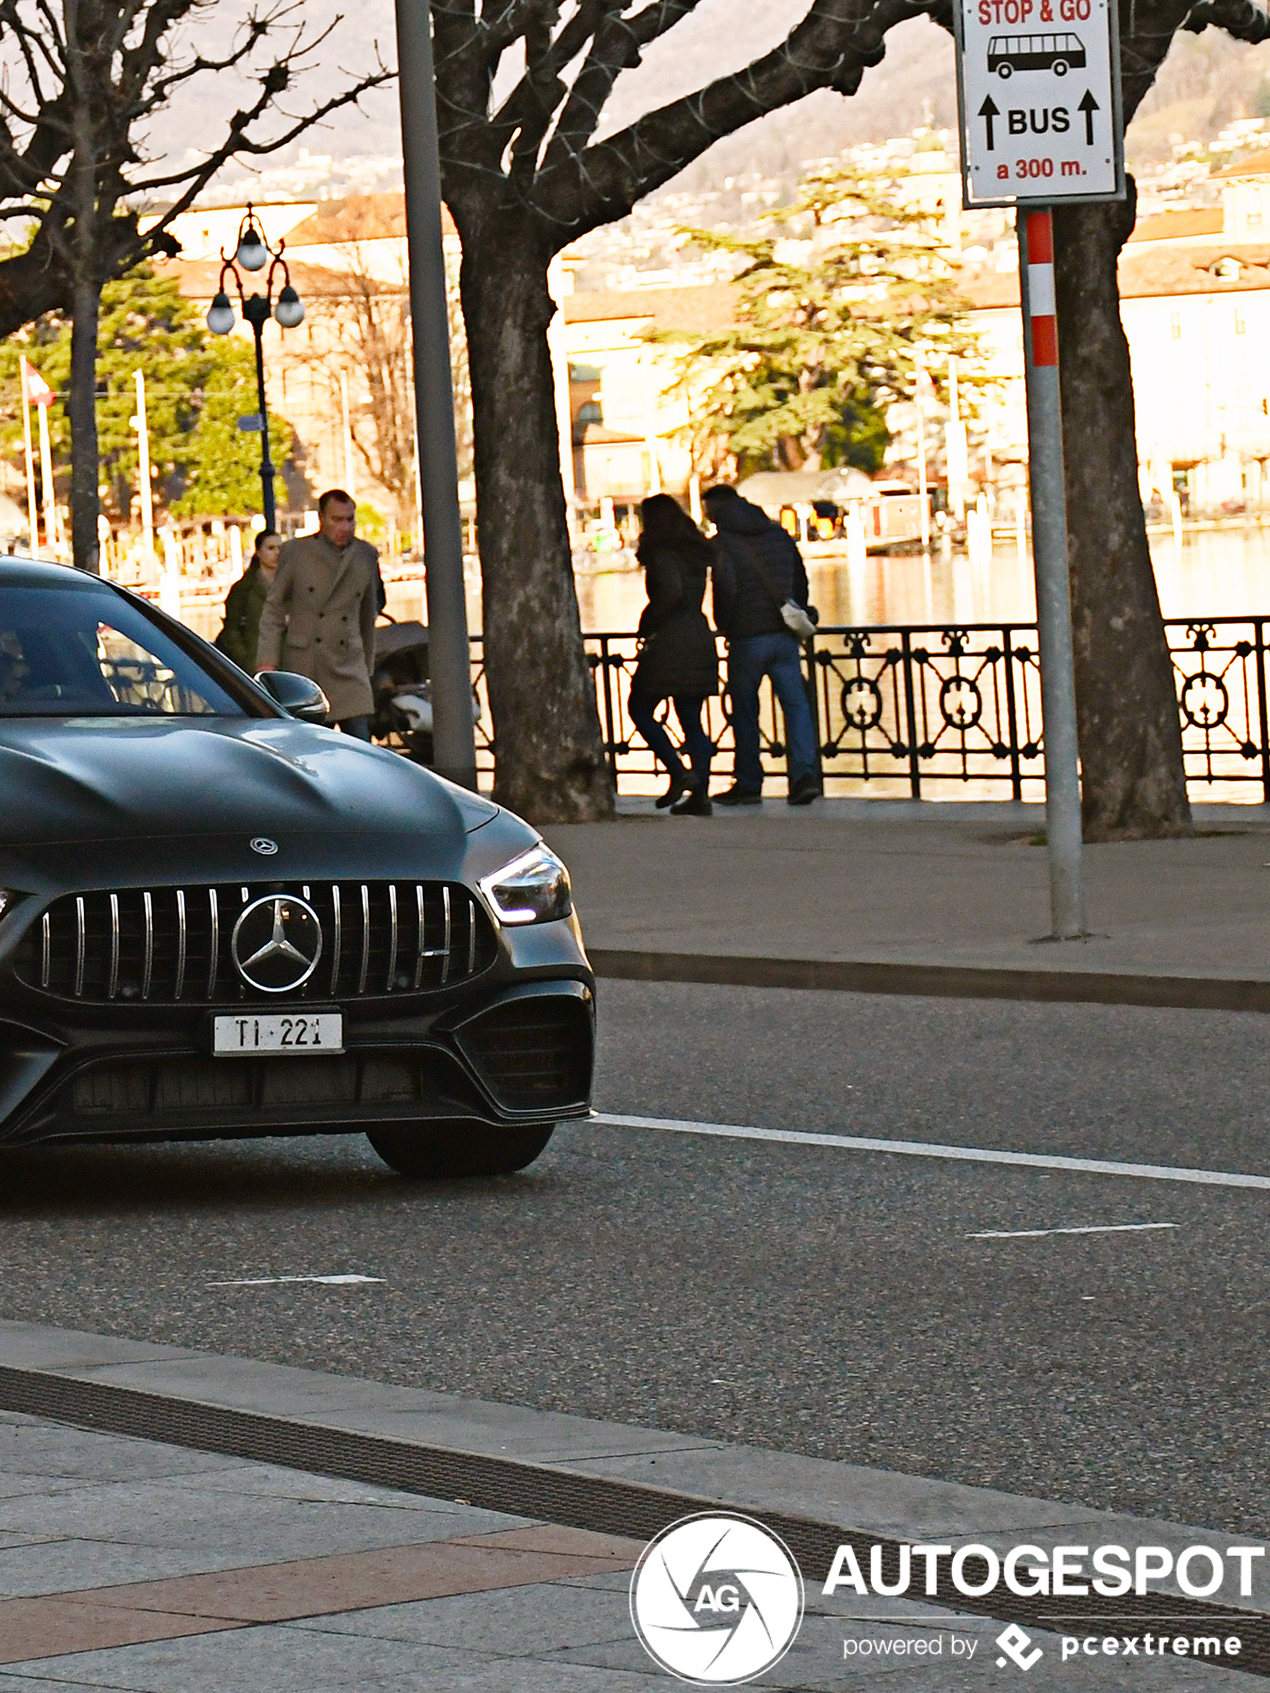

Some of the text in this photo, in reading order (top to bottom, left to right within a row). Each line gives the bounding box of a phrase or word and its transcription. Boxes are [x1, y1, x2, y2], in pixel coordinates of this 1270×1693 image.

[978, 0, 1091, 25] STOP & GO
[1008, 107, 1070, 135] BUS
[997, 158, 1087, 180] a 300 m.
[280, 1018, 322, 1045] 221
